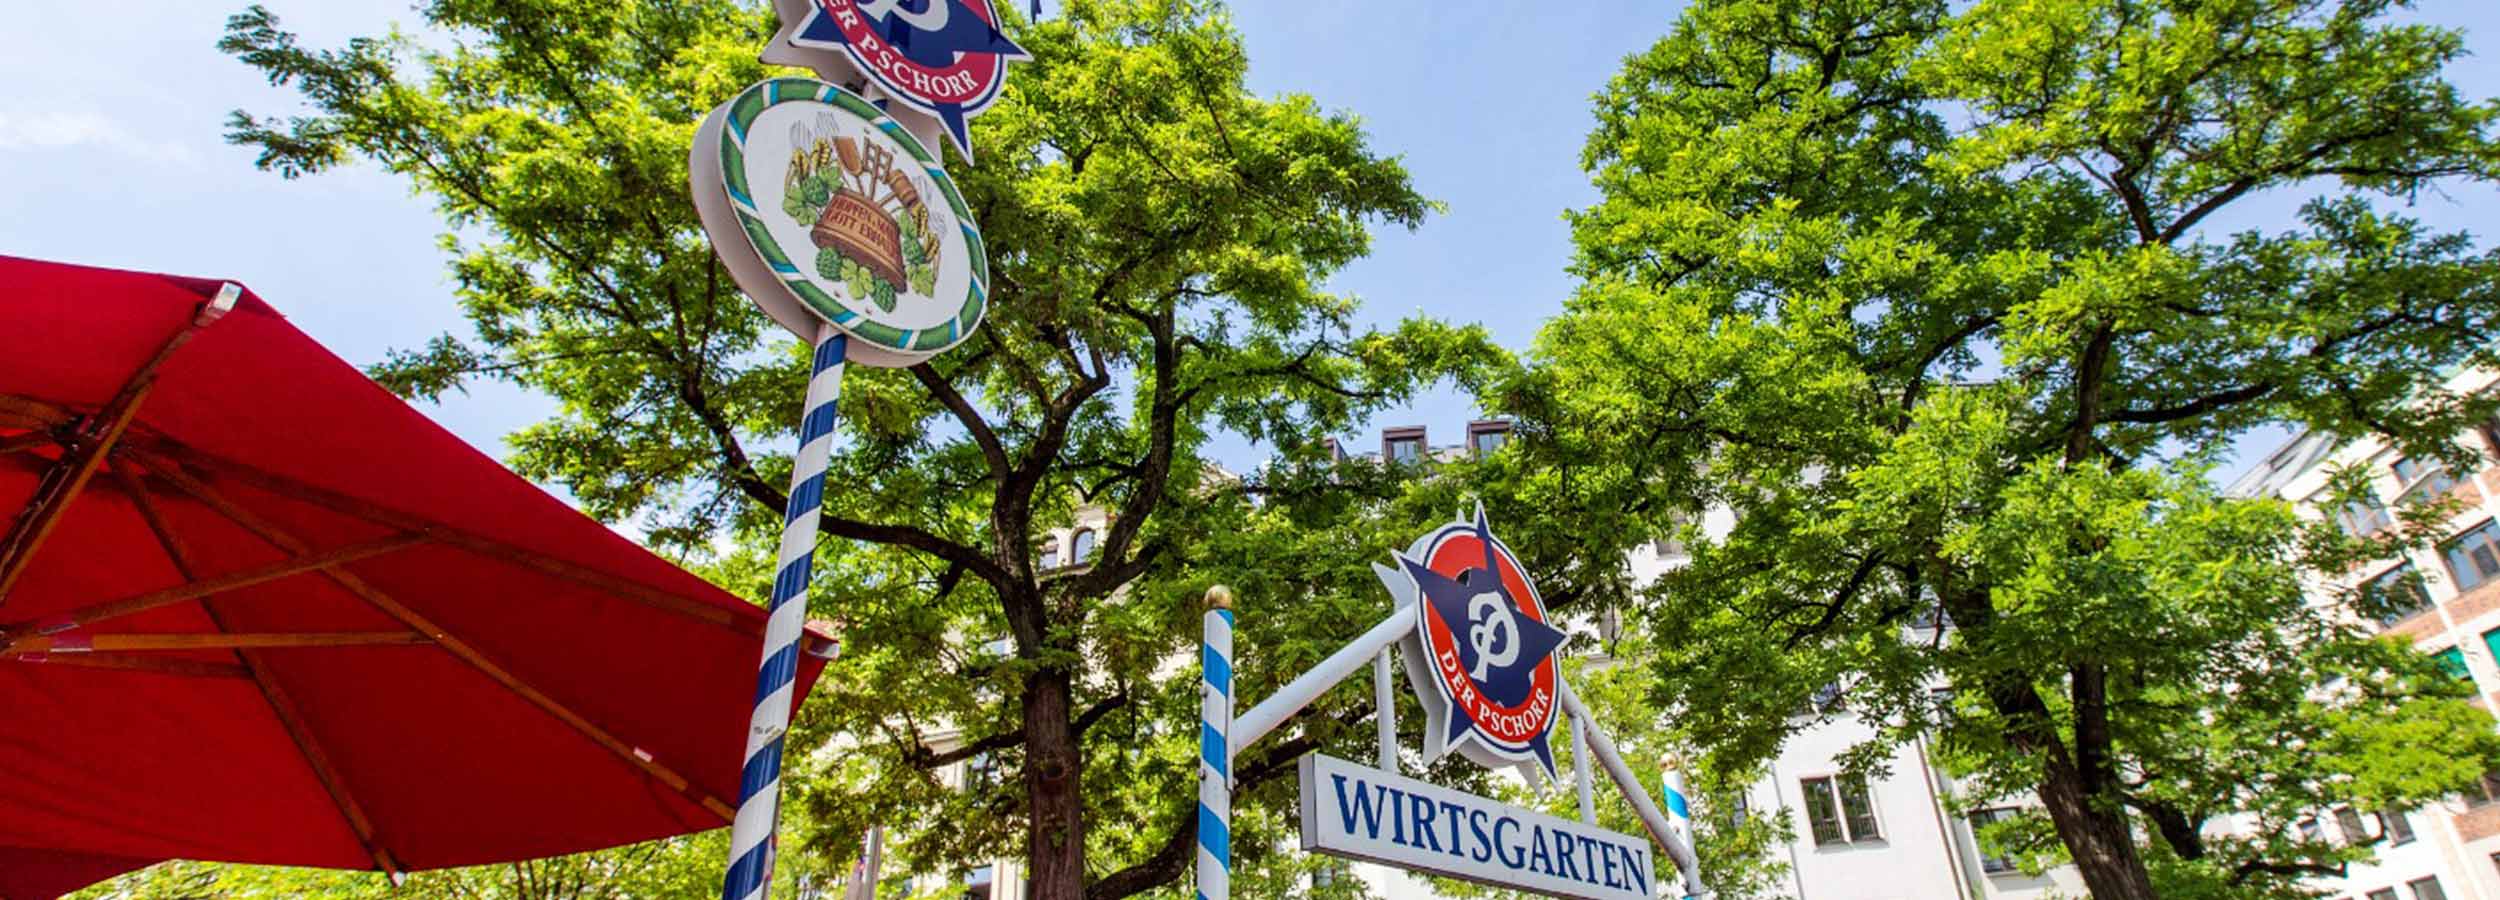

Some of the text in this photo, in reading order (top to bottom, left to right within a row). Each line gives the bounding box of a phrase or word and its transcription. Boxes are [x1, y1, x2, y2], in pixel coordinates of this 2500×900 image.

[859, 33, 979, 97] PSCHORR
[1439, 650, 1550, 737] DER PSCHORR
[1331, 773, 1649, 897] WIRTSGARTEN
